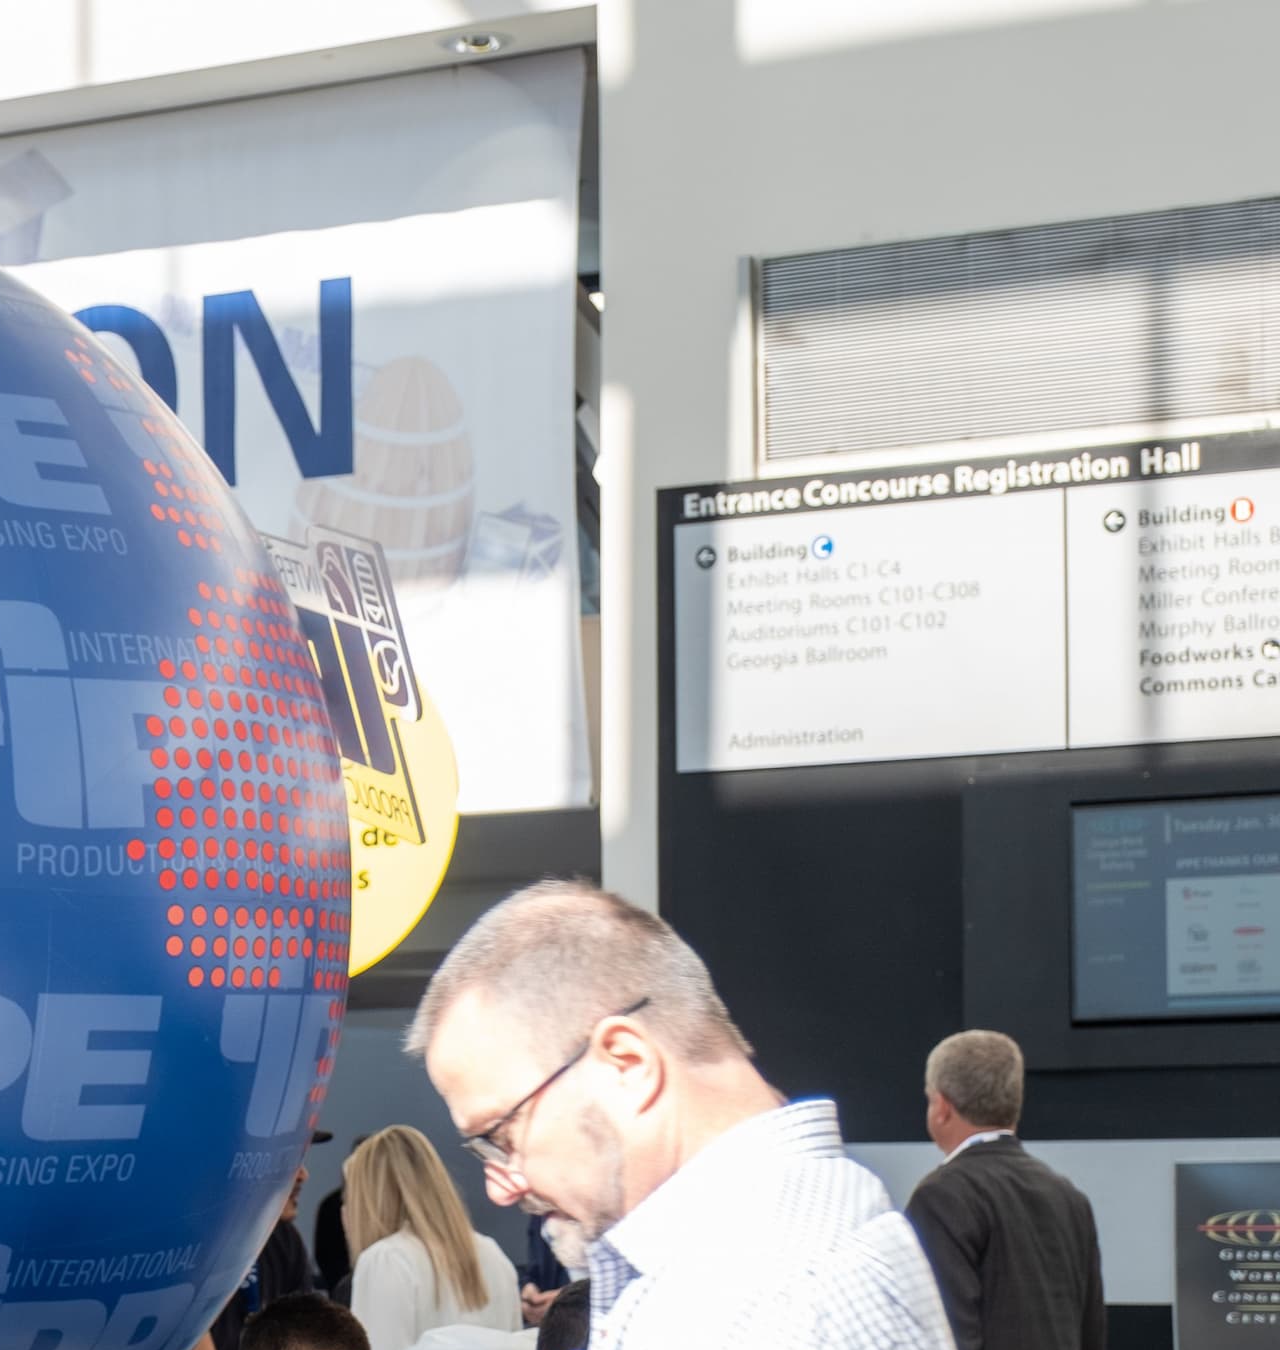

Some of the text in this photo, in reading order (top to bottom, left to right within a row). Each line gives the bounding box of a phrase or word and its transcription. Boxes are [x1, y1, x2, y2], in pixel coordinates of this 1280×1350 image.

[683, 442, 1201, 519] Entrance Concourse Registration Hall
[1138, 503, 1226, 528] Building
[62, 524, 128, 557] EXPO
[727, 543, 809, 563] Building
[1138, 533, 1205, 557] Exhibit
[1213, 527, 1261, 549] Halls
[726, 559, 901, 591] Exhibit Halls C1-C4
[1139, 561, 1220, 584] Meeting
[726, 596, 803, 617] Meeting
[809, 591, 872, 610] Rooms
[1139, 591, 1193, 612] Miller
[726, 609, 948, 645] Auditoriums C101-C102
[1139, 618, 1215, 642] Murphy
[726, 643, 888, 673] Georgia Ballroom
[1139, 642, 1255, 668] Foodworks
[1139, 673, 1245, 697] Commons
[728, 725, 864, 751] Administration
[64, 1151, 137, 1183] EXPO
[10, 1241, 202, 1289] INTERNATIONAL
